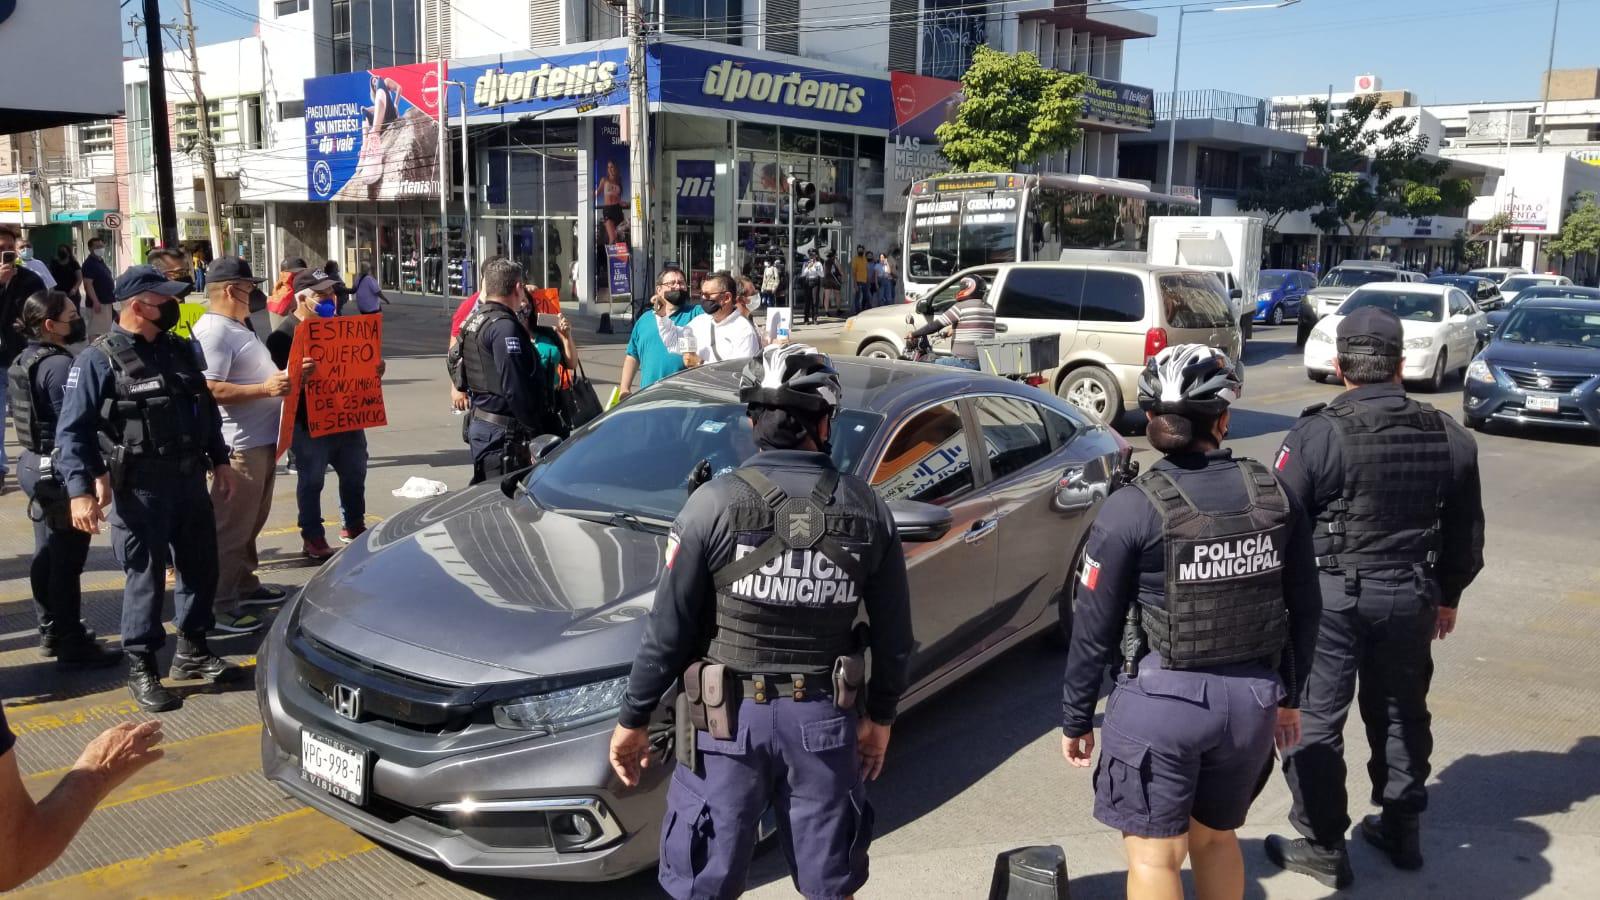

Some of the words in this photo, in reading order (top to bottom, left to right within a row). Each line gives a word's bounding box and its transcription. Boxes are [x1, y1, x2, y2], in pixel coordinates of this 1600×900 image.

[474, 60, 617, 107] dportenis
[702, 60, 865, 113] dportenis
[305, 106, 323, 122] ¡PAGO
[324, 102, 360, 119] QUINCENAL
[315, 121, 326, 134] SIN
[327, 116, 358, 133] INTERÉS!
[895, 135, 920, 150] LAS
[894, 168, 928, 180] MARC
[400, 180, 431, 194] rtenis
[308, 320, 379, 341] ESTRADA
[309, 343, 374, 364] QUIERO
[328, 366, 346, 377] MI
[315, 399, 334, 411] DE
[343, 396, 358, 409] 25
[310, 421, 320, 432] DE
[324, 410, 386, 431] SERVICIO
[1194, 534, 1274, 562] POLICÍA
[1180, 550, 1281, 580] MUNICIPAL
[732, 574, 858, 604] MUNICIPAL
[303, 740, 361, 786] VPG-998-A
